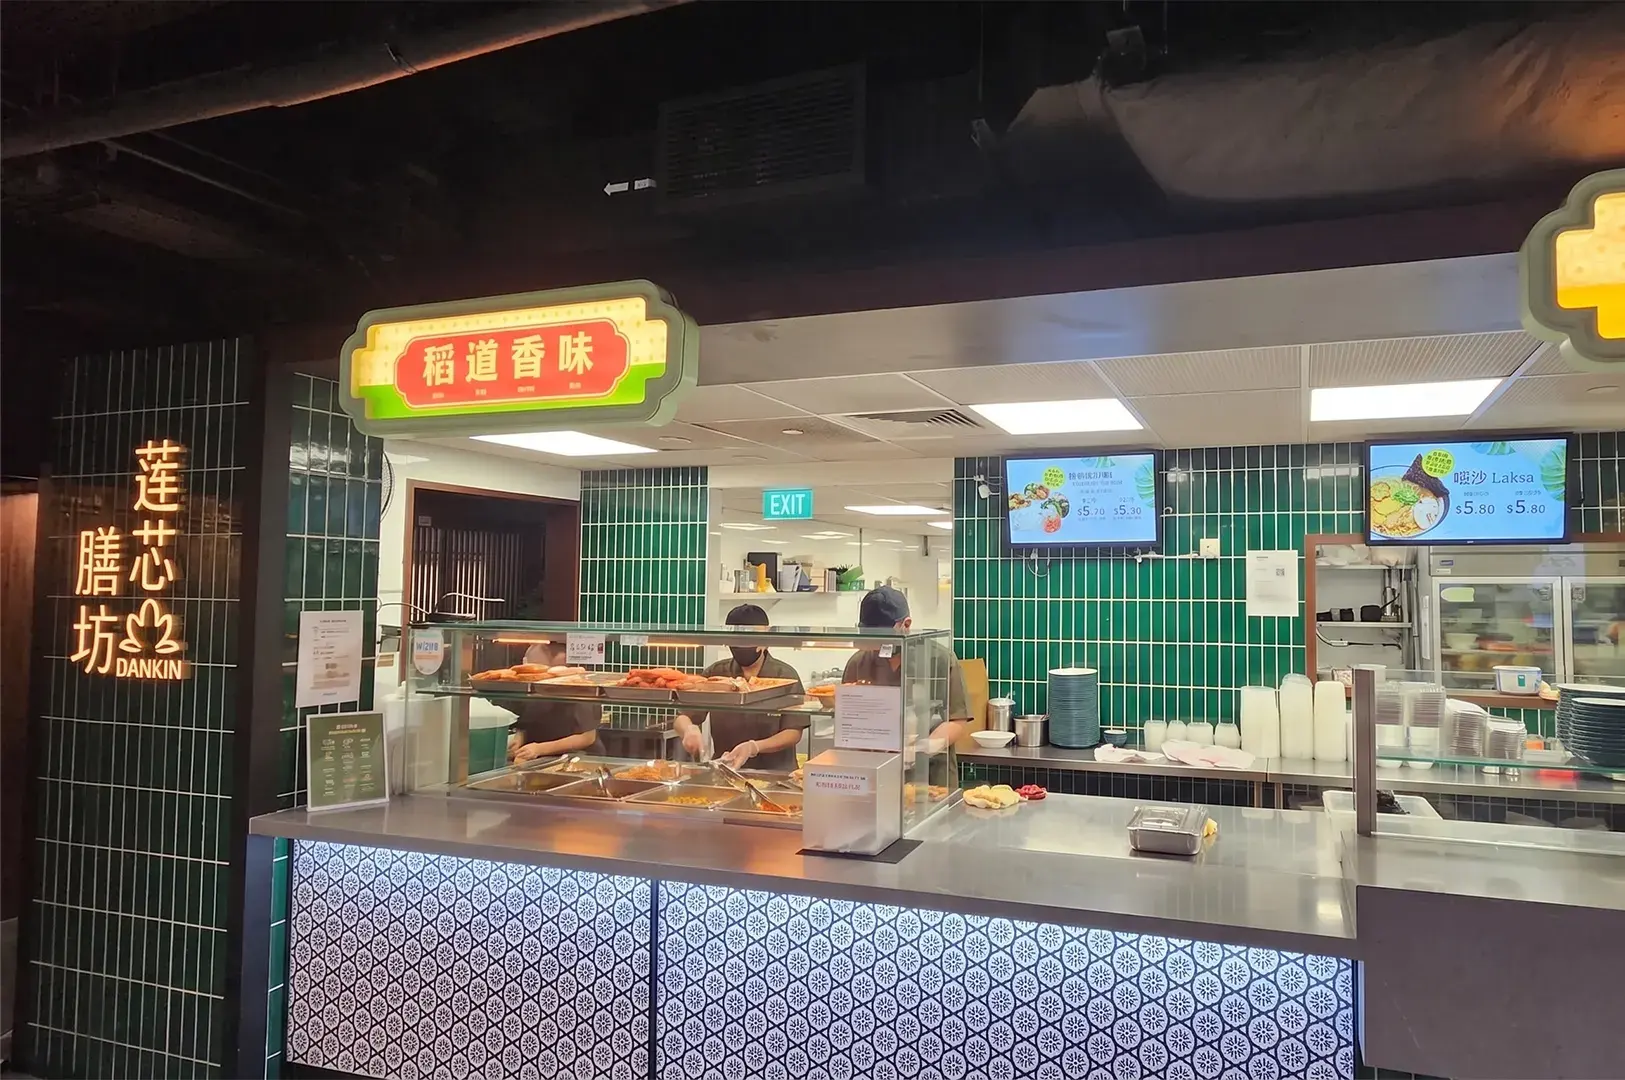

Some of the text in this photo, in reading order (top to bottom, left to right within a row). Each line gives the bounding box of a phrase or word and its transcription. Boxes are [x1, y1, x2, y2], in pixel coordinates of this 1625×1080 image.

[422, 331, 595, 387] 稻道香味
[1492, 471, 1534, 484] Laksa
[770, 493, 806, 516] EXIT
[1077, 505, 1106, 517] $5.70
[1113, 504, 1142, 516] $5.30
[1455, 500, 1495, 515] $5.80
[1506, 499, 1546, 514] $5.80
[129, 439, 182, 592] 莲芯
[70, 526, 121, 675] 膳坊
[116, 657, 183, 680] DANKIN
